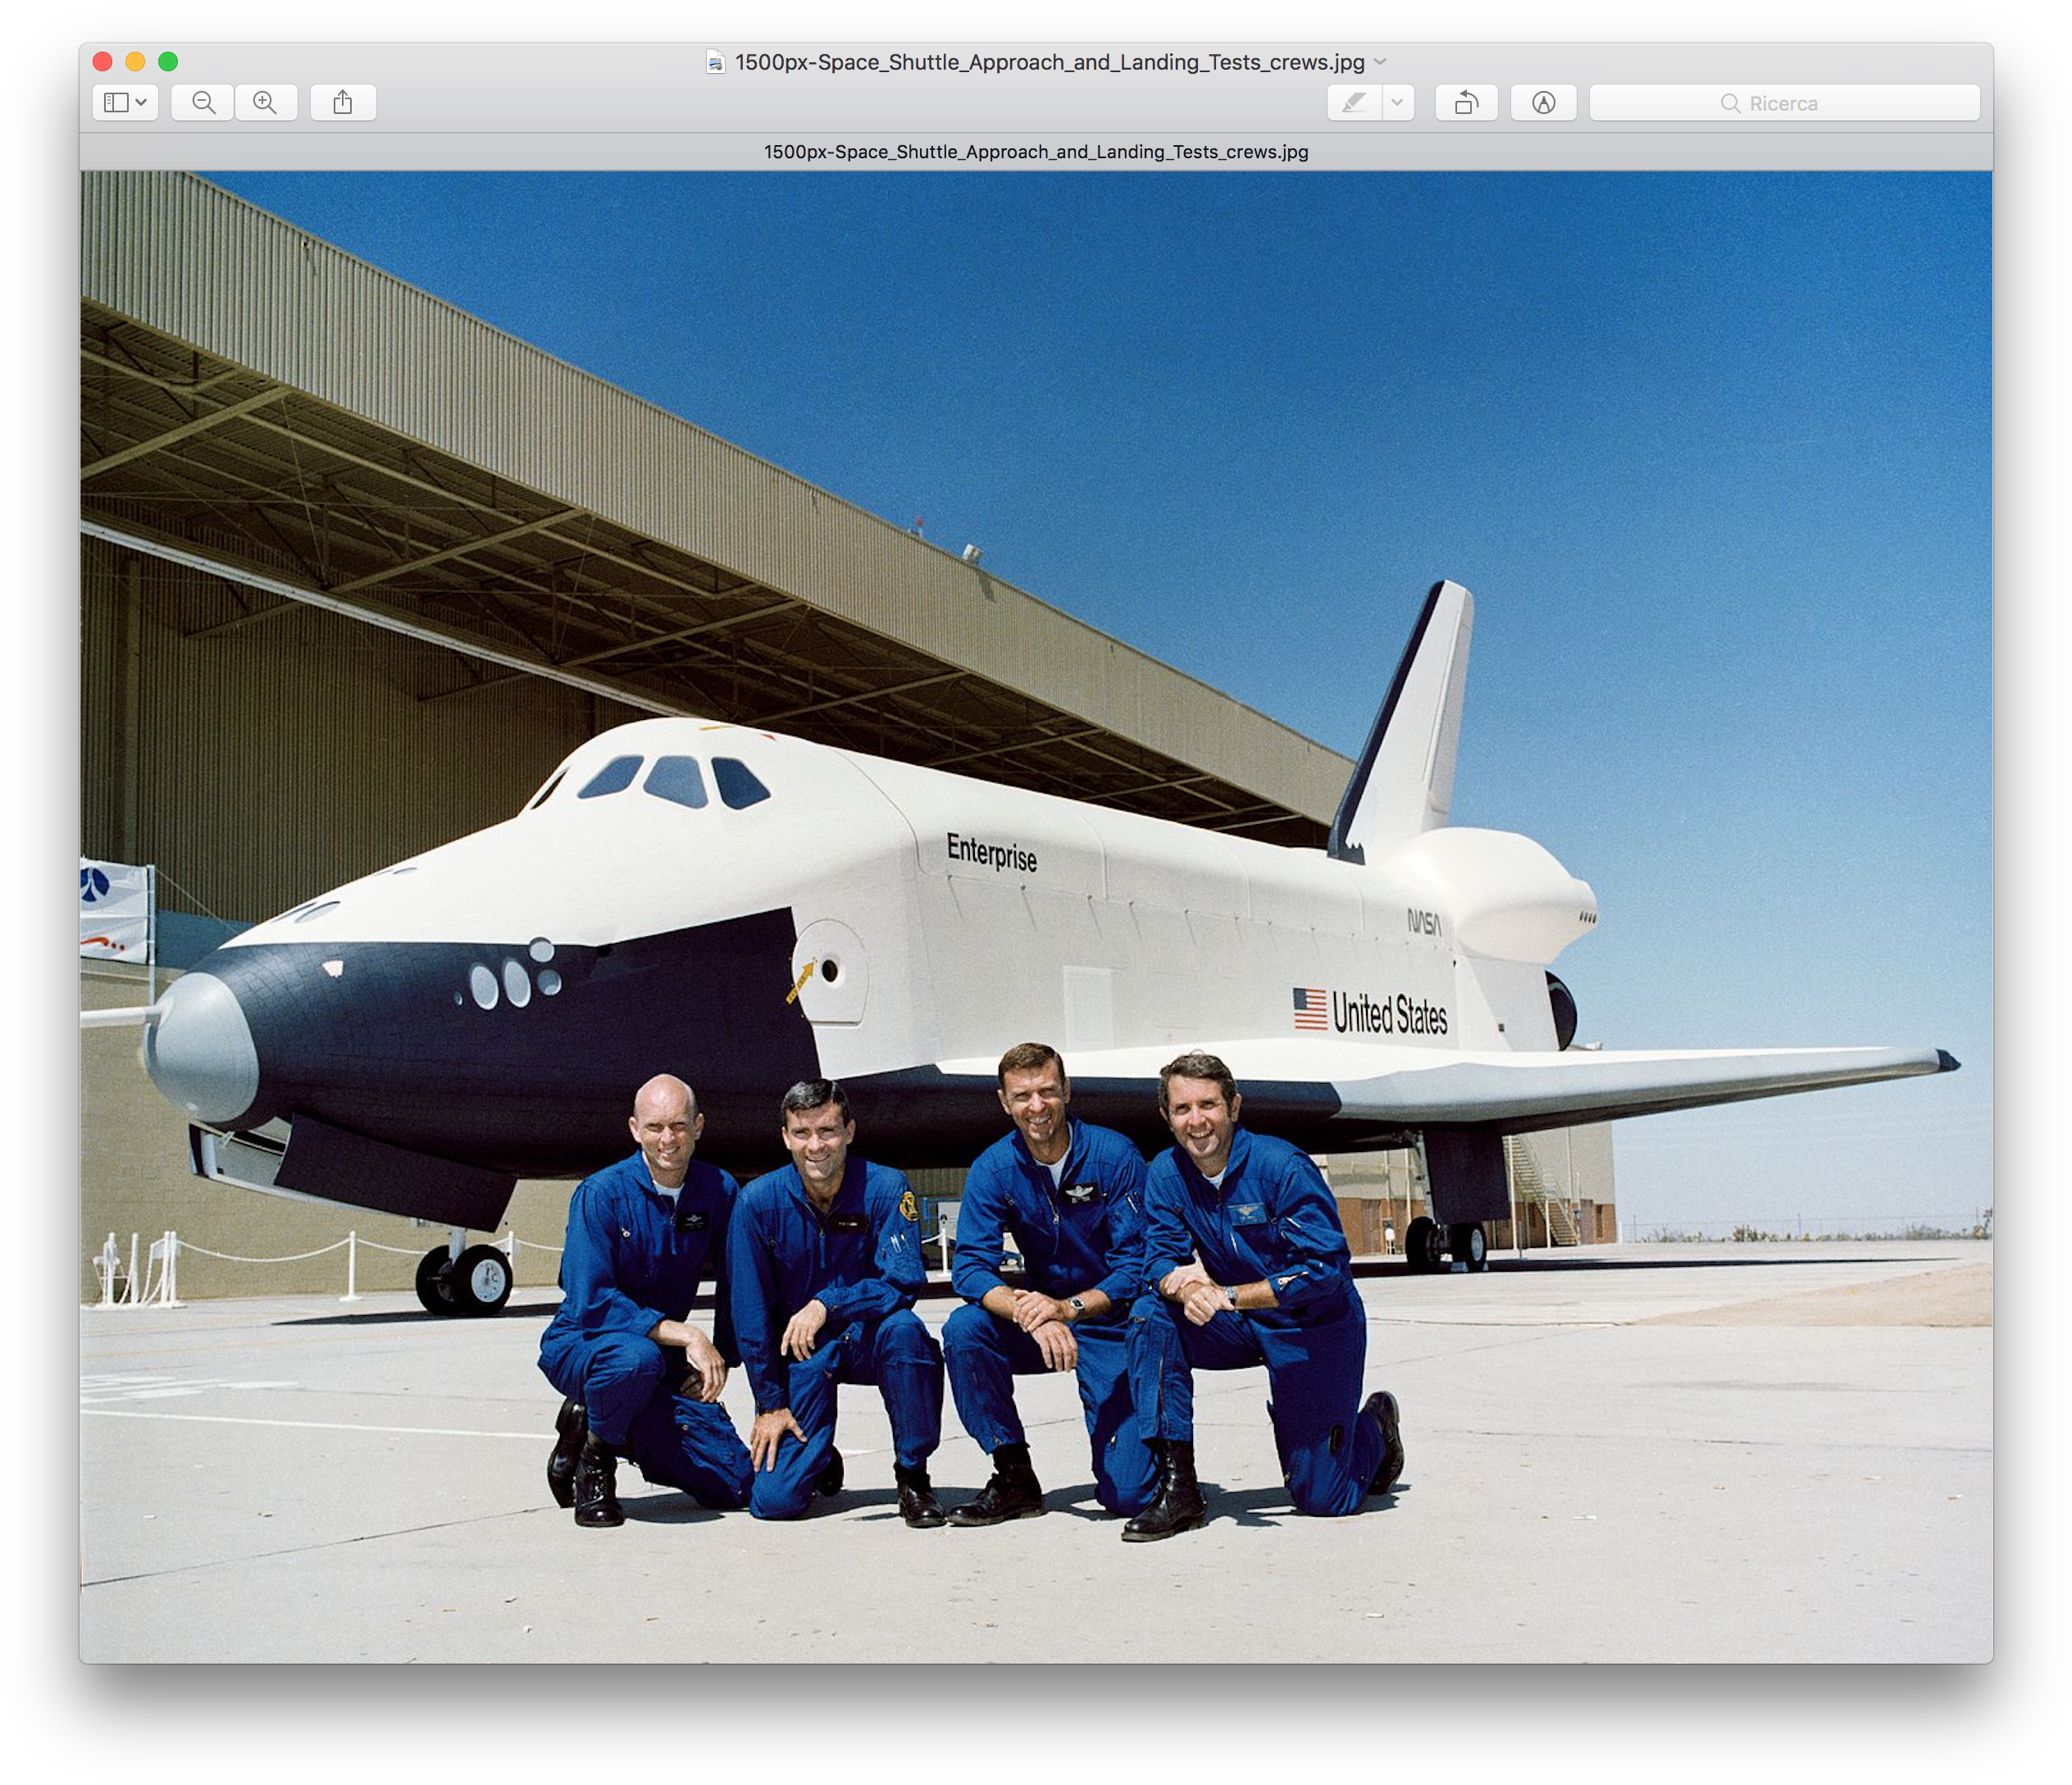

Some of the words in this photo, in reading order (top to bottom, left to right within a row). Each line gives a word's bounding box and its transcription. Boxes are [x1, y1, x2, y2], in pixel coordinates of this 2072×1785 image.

[735, 52, 1365, 75] 1500px-Space_Shuttle_Approach_and_Landing_Tests_crews.jpg
[1750, 94, 1819, 112] Ricerca
[764, 143, 1309, 162] 1500px-Space_Shuttle_Approach_and_Landing_Tests_crews.jpg
[947, 832, 1037, 872] Enterprise
[1407, 907, 1441, 937] NASA
[1332, 990, 1393, 1034] United
[1396, 993, 1448, 1035] States
